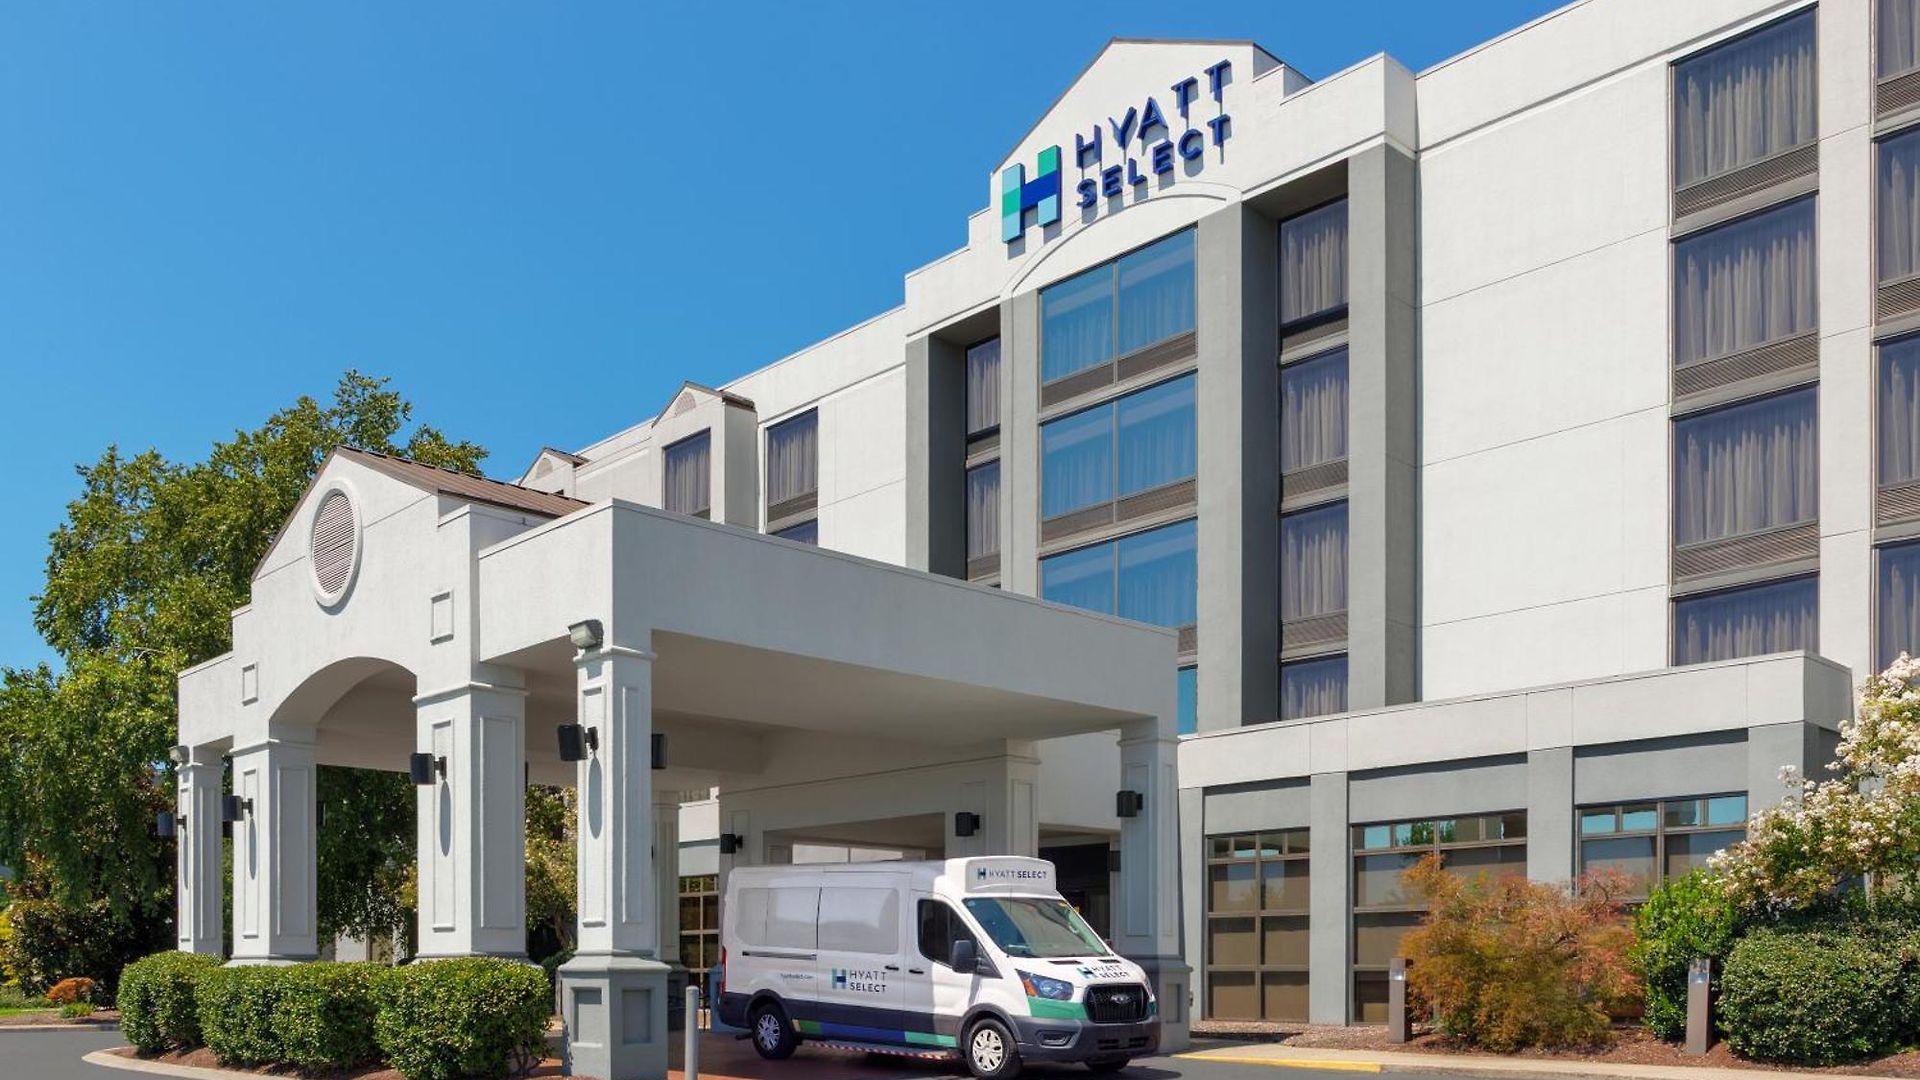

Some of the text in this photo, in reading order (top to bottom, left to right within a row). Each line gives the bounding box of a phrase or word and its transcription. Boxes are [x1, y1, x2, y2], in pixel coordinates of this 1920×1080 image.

[1075, 59, 1232, 169] HYATT
[1076, 114, 1231, 209] SELECT
[989, 869, 1015, 879] HYATT
[1017, 870, 1047, 879] SELECT
[850, 969, 887, 981] HYATT
[850, 982, 887, 992] SELECT
